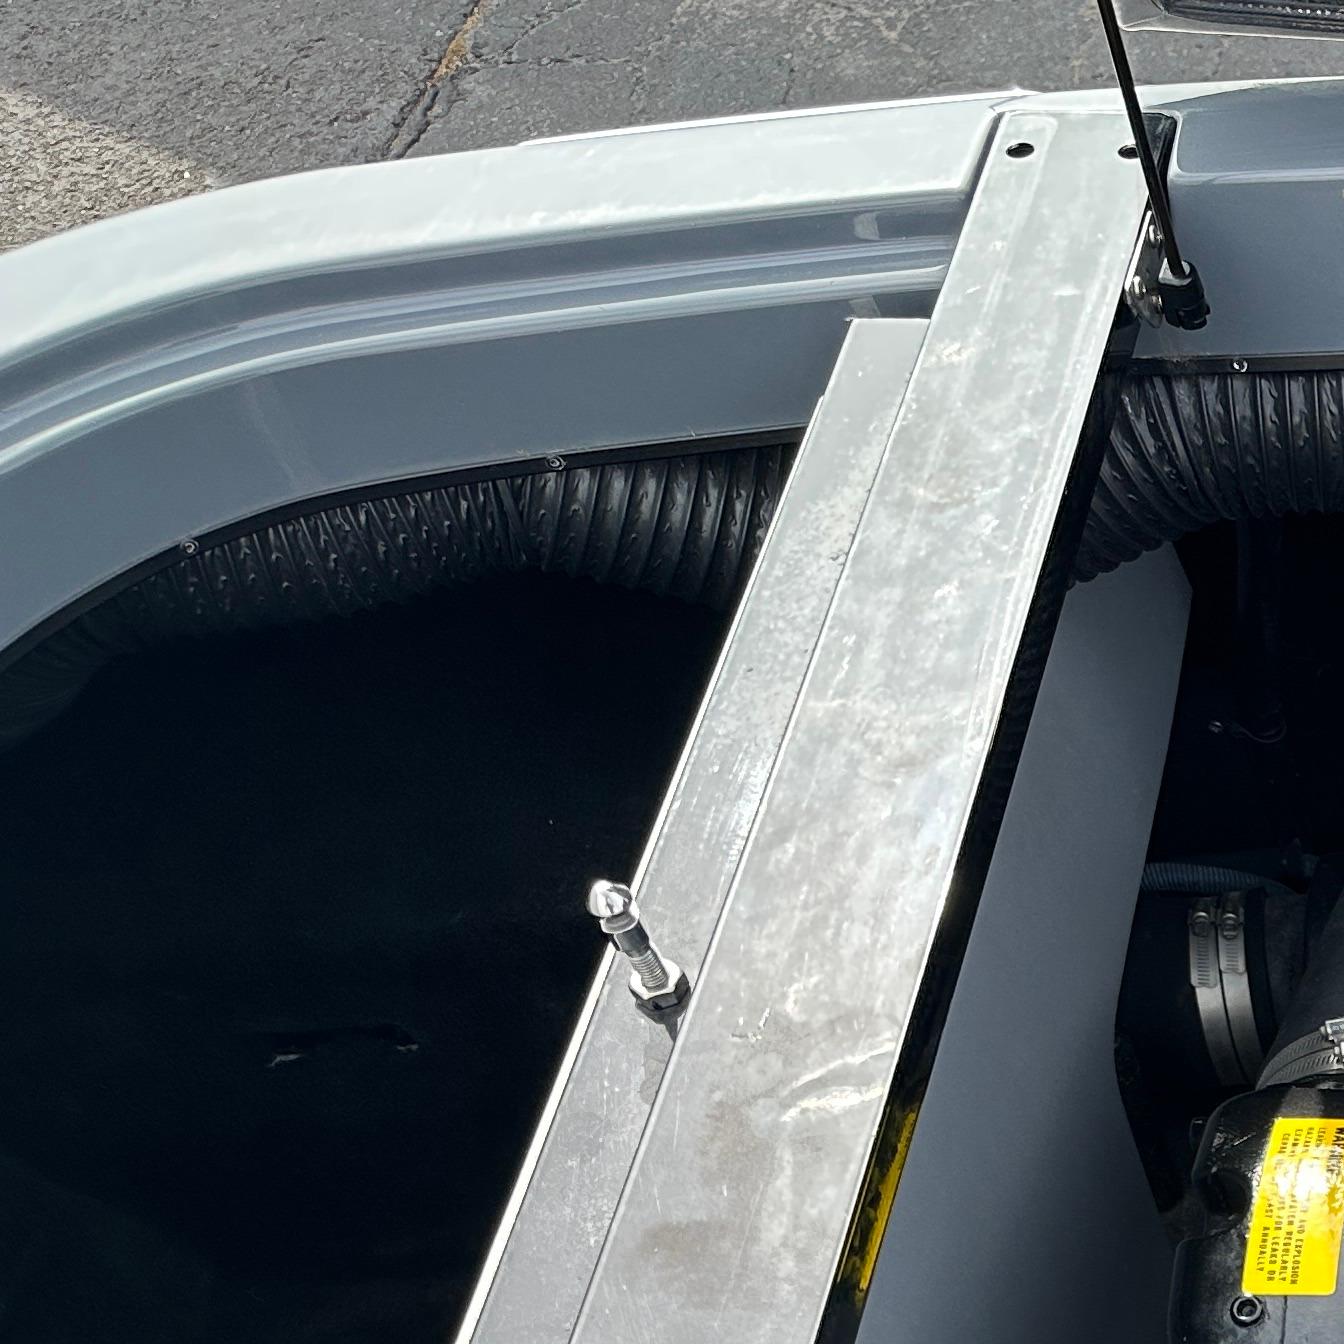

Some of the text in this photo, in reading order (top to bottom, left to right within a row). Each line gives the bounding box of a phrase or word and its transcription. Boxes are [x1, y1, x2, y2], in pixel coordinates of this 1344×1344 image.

[1256, 1226, 1271, 1272] ANNUALLY
[1268, 1236, 1281, 1265] LEAKS
[1279, 1230, 1293, 1282] REGULARLY
[1289, 1238, 1304, 1285] EXPLOSION
[1266, 1269, 1276, 1282] OR
